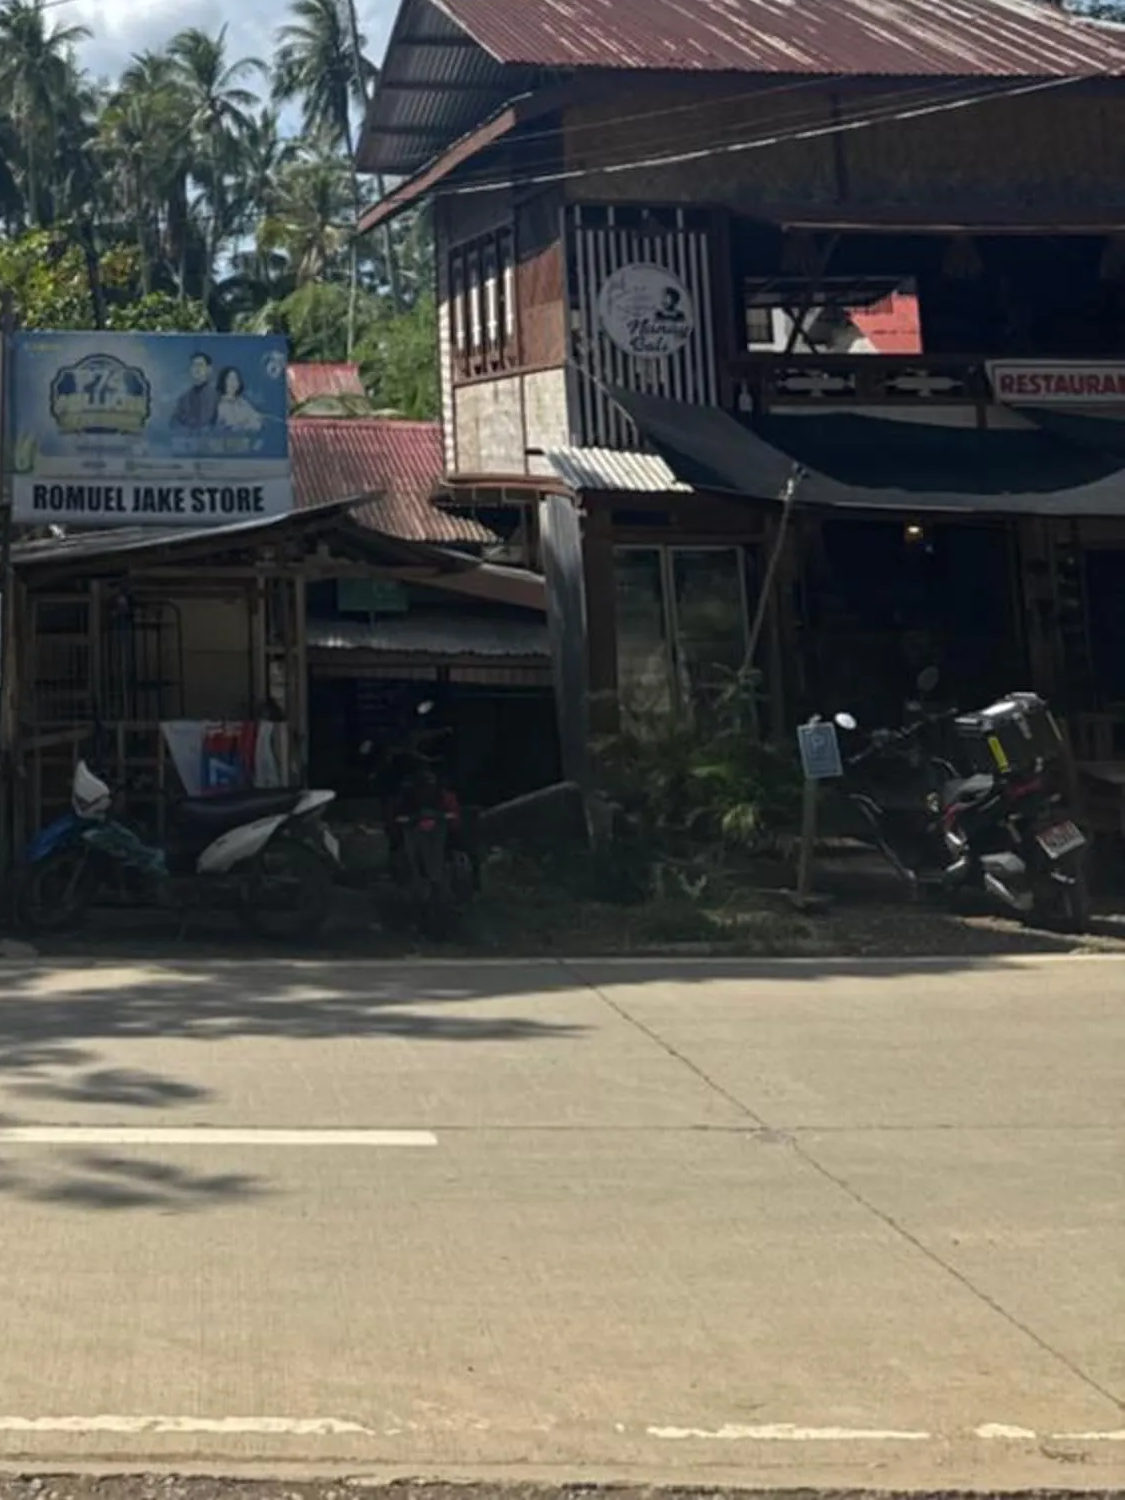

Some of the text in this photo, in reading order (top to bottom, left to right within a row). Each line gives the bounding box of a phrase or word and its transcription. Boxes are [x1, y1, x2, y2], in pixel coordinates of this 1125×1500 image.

[33, 485, 265, 513] ROMUEL JAKE STORE
